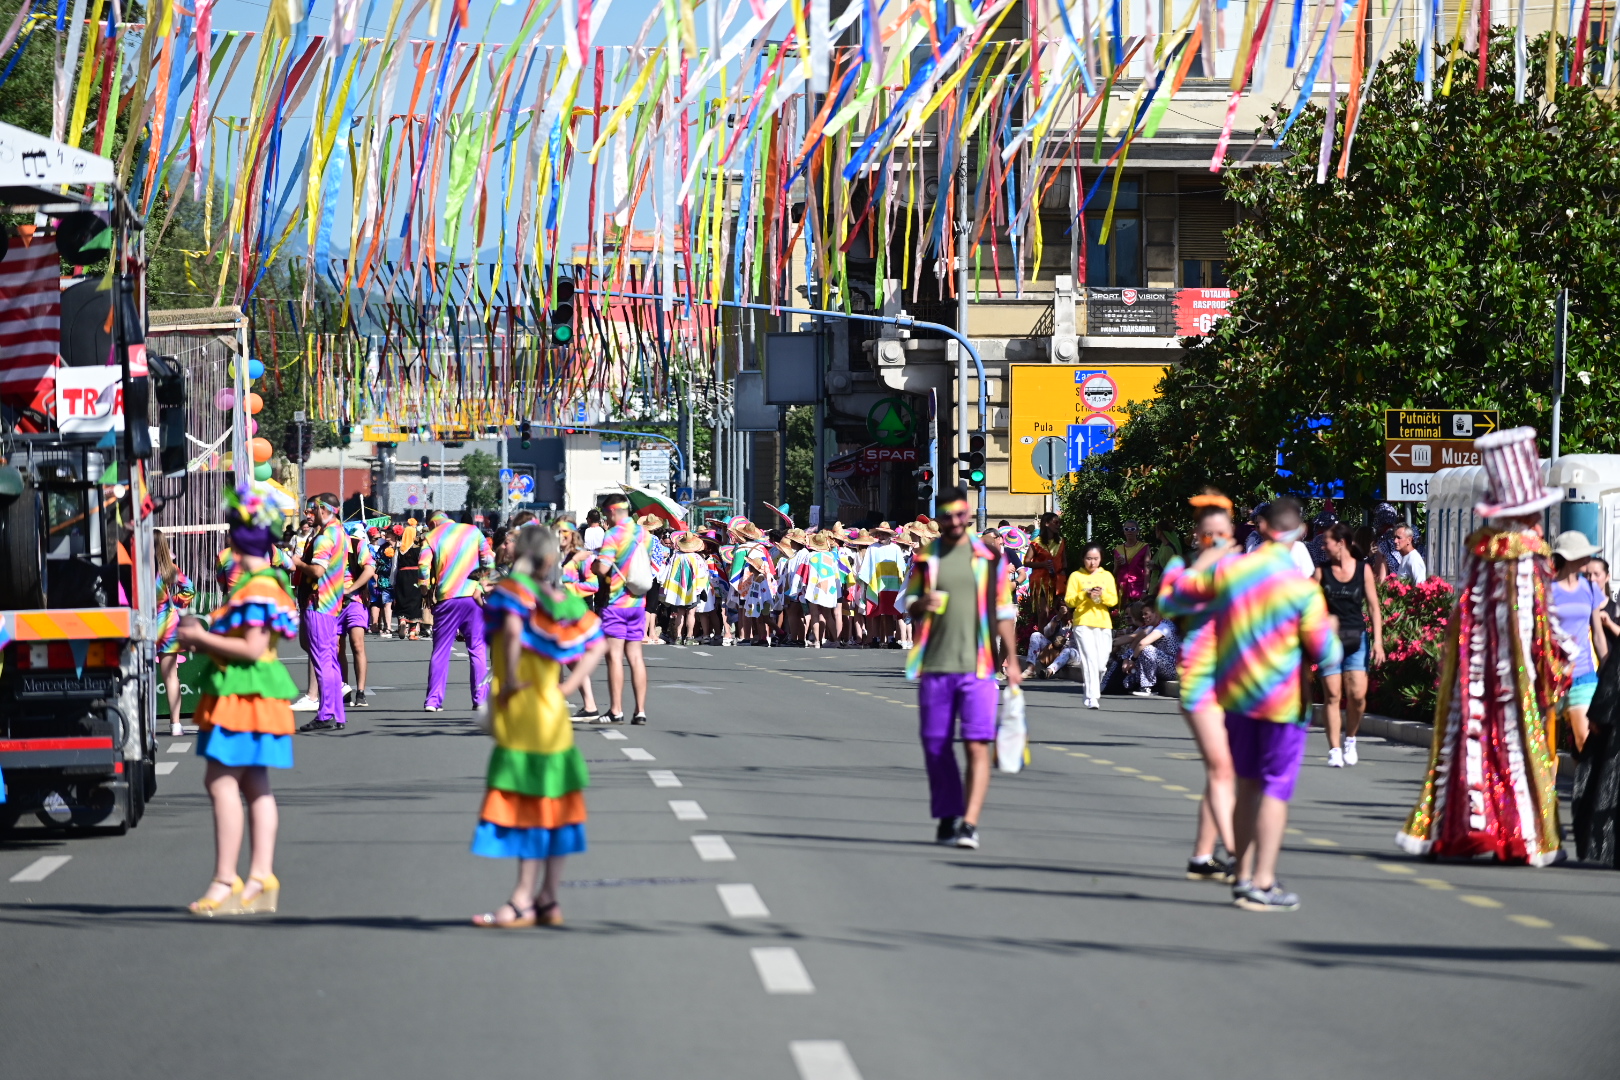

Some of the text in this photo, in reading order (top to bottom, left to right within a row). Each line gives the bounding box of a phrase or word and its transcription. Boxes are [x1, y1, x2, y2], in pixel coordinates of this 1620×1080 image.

[1200, 289, 1231, 298] TOTALNA
[1119, 325, 1156, 333] TRANSADRIA
[1399, 411, 1441, 425] Putnički
[1034, 421, 1053, 432] Pula
[1399, 425, 1442, 438] terminal
[866, 449, 915, 460] SPAR
[23, 677, 112, 692] Mercedes-Benz
